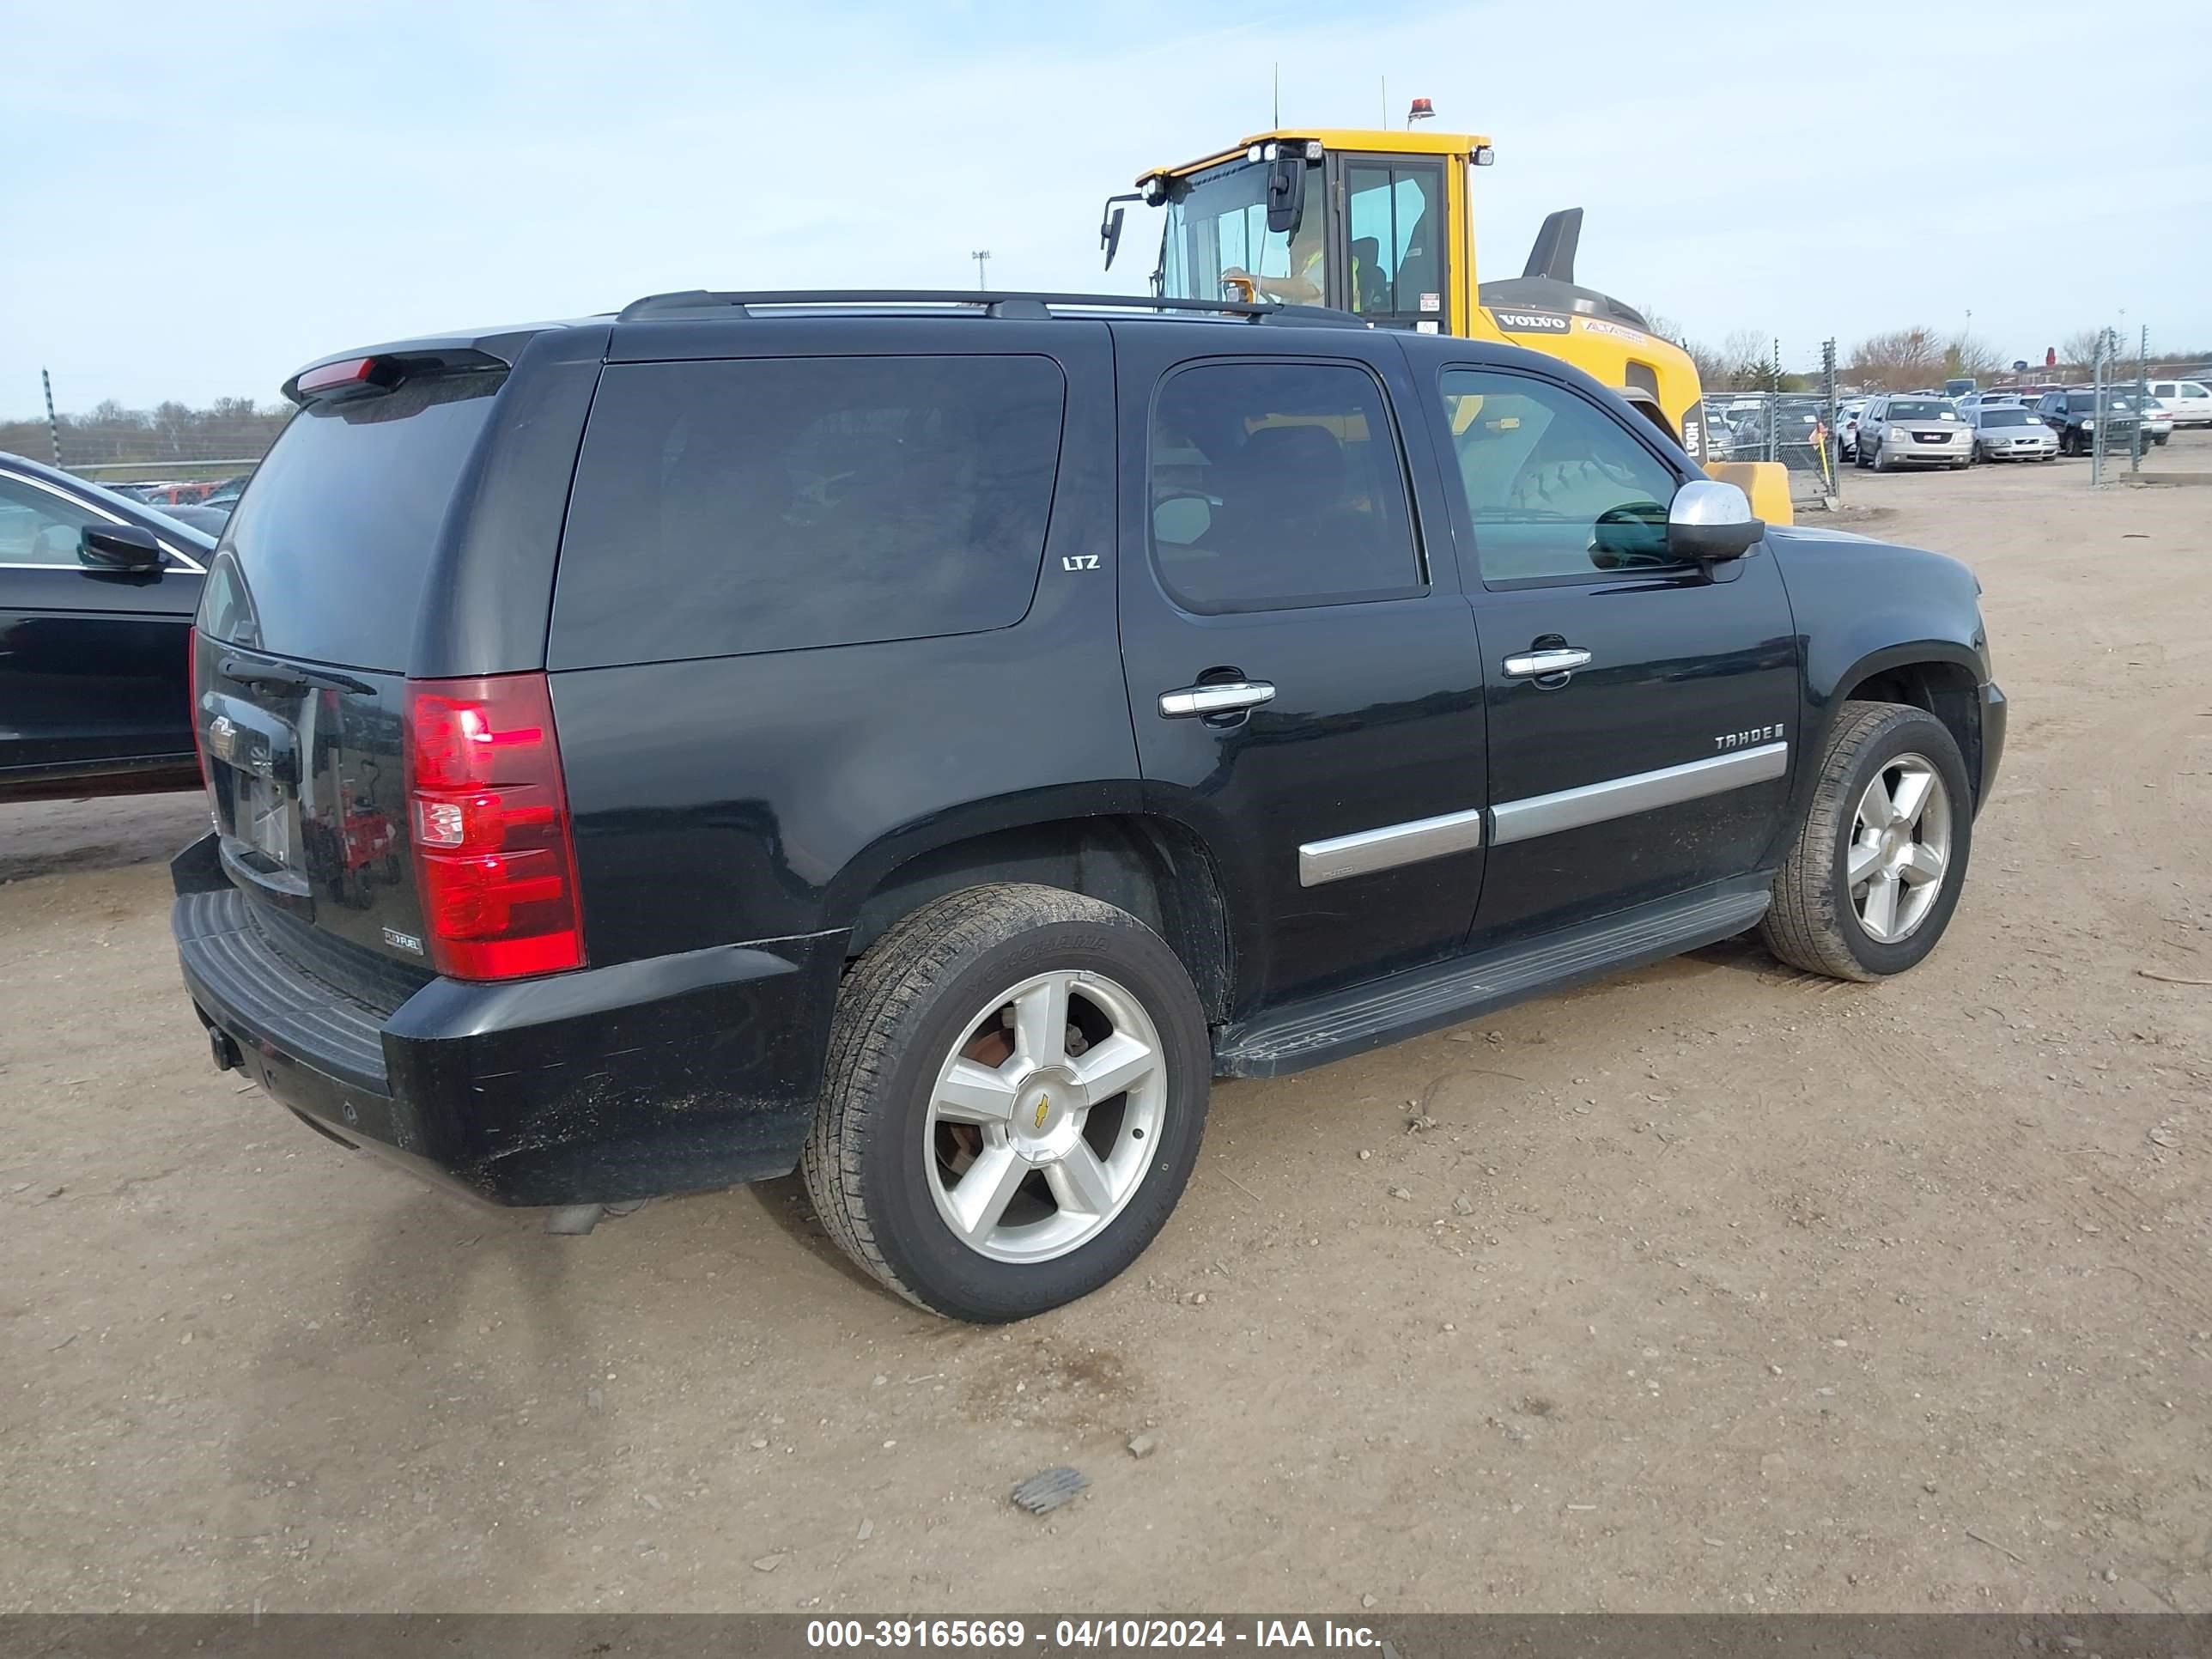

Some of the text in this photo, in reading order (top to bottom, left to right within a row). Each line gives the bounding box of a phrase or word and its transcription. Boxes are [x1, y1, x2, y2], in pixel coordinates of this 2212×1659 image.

[1498, 314, 1565, 329] VOLVO
[1685, 422, 1699, 457] L90H
[1062, 555, 1101, 571] LTZ
[1715, 726, 1773, 750] TAHOE
